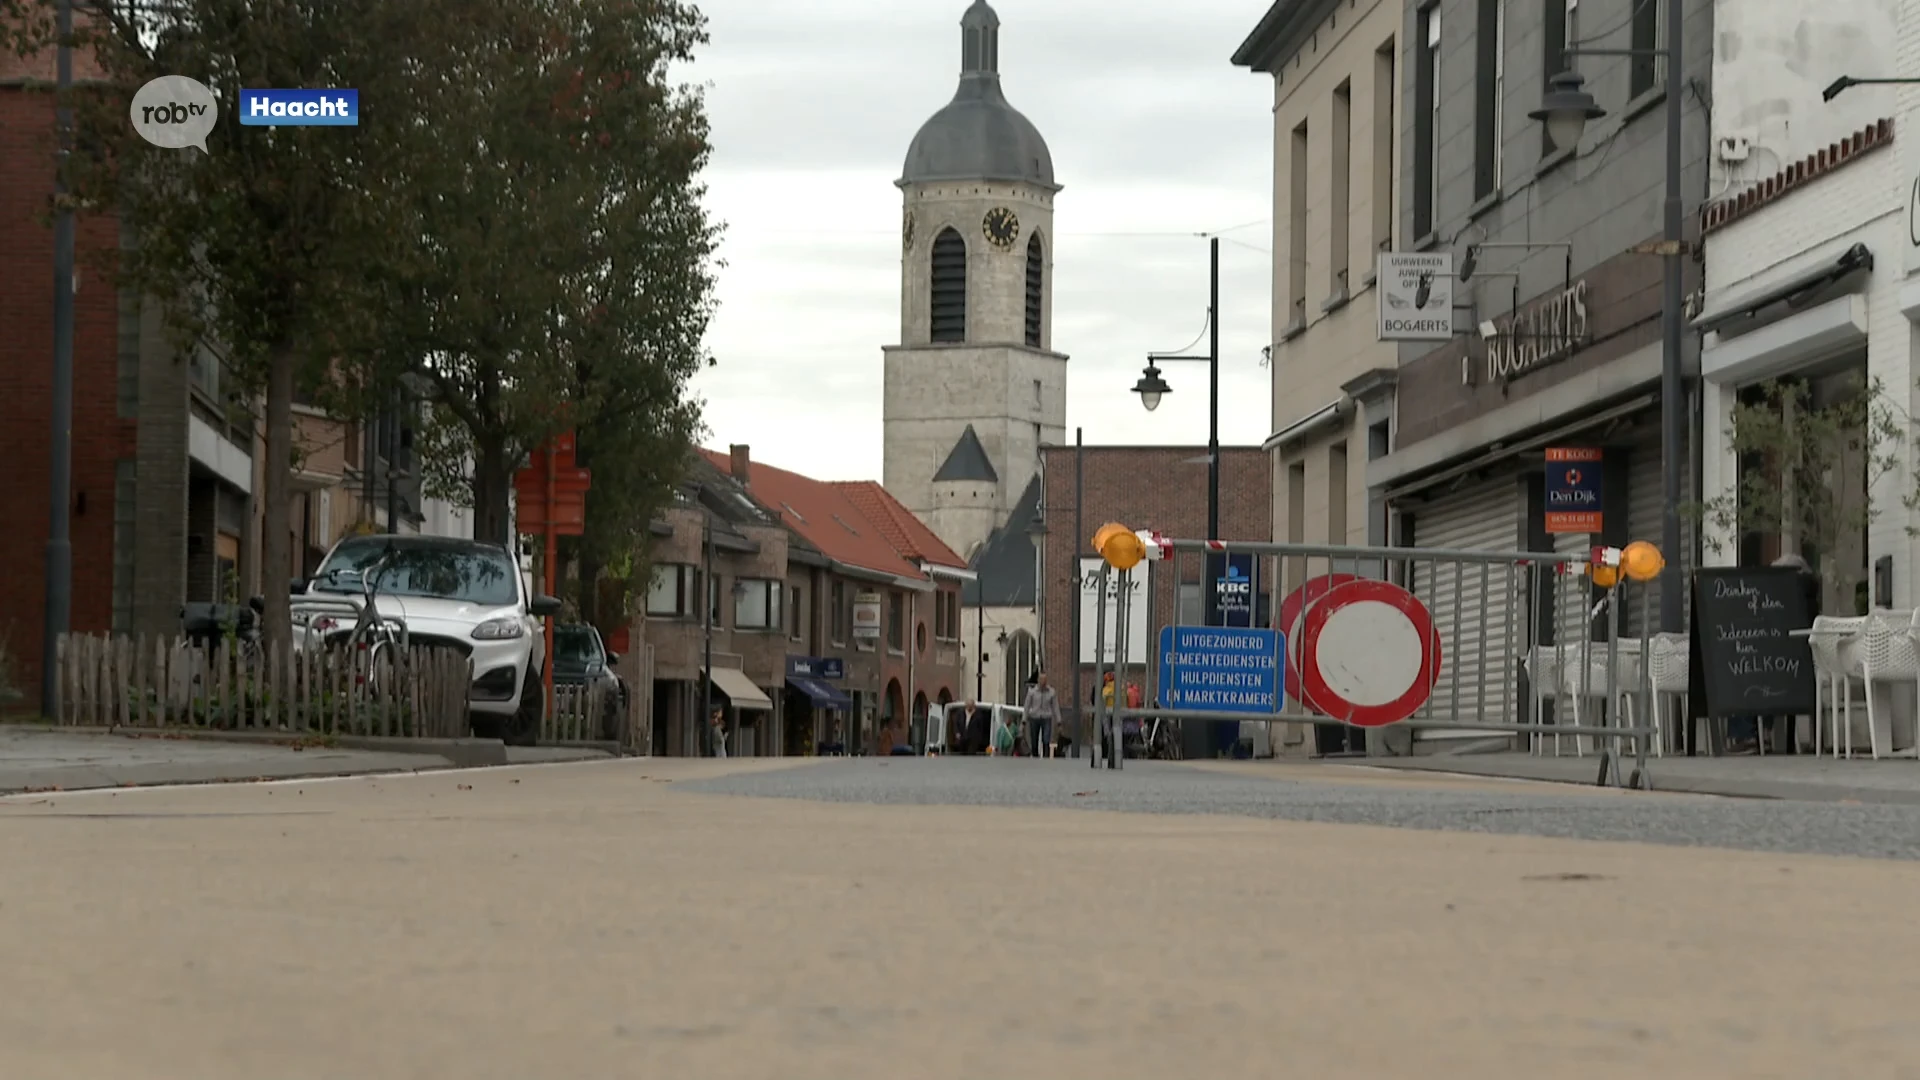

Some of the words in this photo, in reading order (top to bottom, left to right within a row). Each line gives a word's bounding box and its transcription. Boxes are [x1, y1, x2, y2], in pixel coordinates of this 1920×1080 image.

[1391, 257, 1443, 267] UURWERKEN
[1385, 320, 1449, 332] BOGAERTS
[1487, 279, 1586, 382] BOGAERTS
[1551, 448, 1562, 460] TE
[1566, 448, 1595, 460] KOOP
[1550, 490, 1572, 502] Den
[1574, 489, 1596, 504] Dijk
[1217, 583, 1249, 593] KBC
[1714, 578, 1760, 598] Drinken
[1747, 594, 1759, 615] of
[1770, 627, 1781, 637] is
[1181, 633, 1263, 650] UITGEZONDERD
[1165, 651, 1275, 669] GEMEENTEDIENSTEN
[1728, 656, 1799, 678] WELKOM
[1180, 671, 1262, 687] HULPDIENSTEN
[1184, 689, 1274, 706] MARKTKRAMERS
